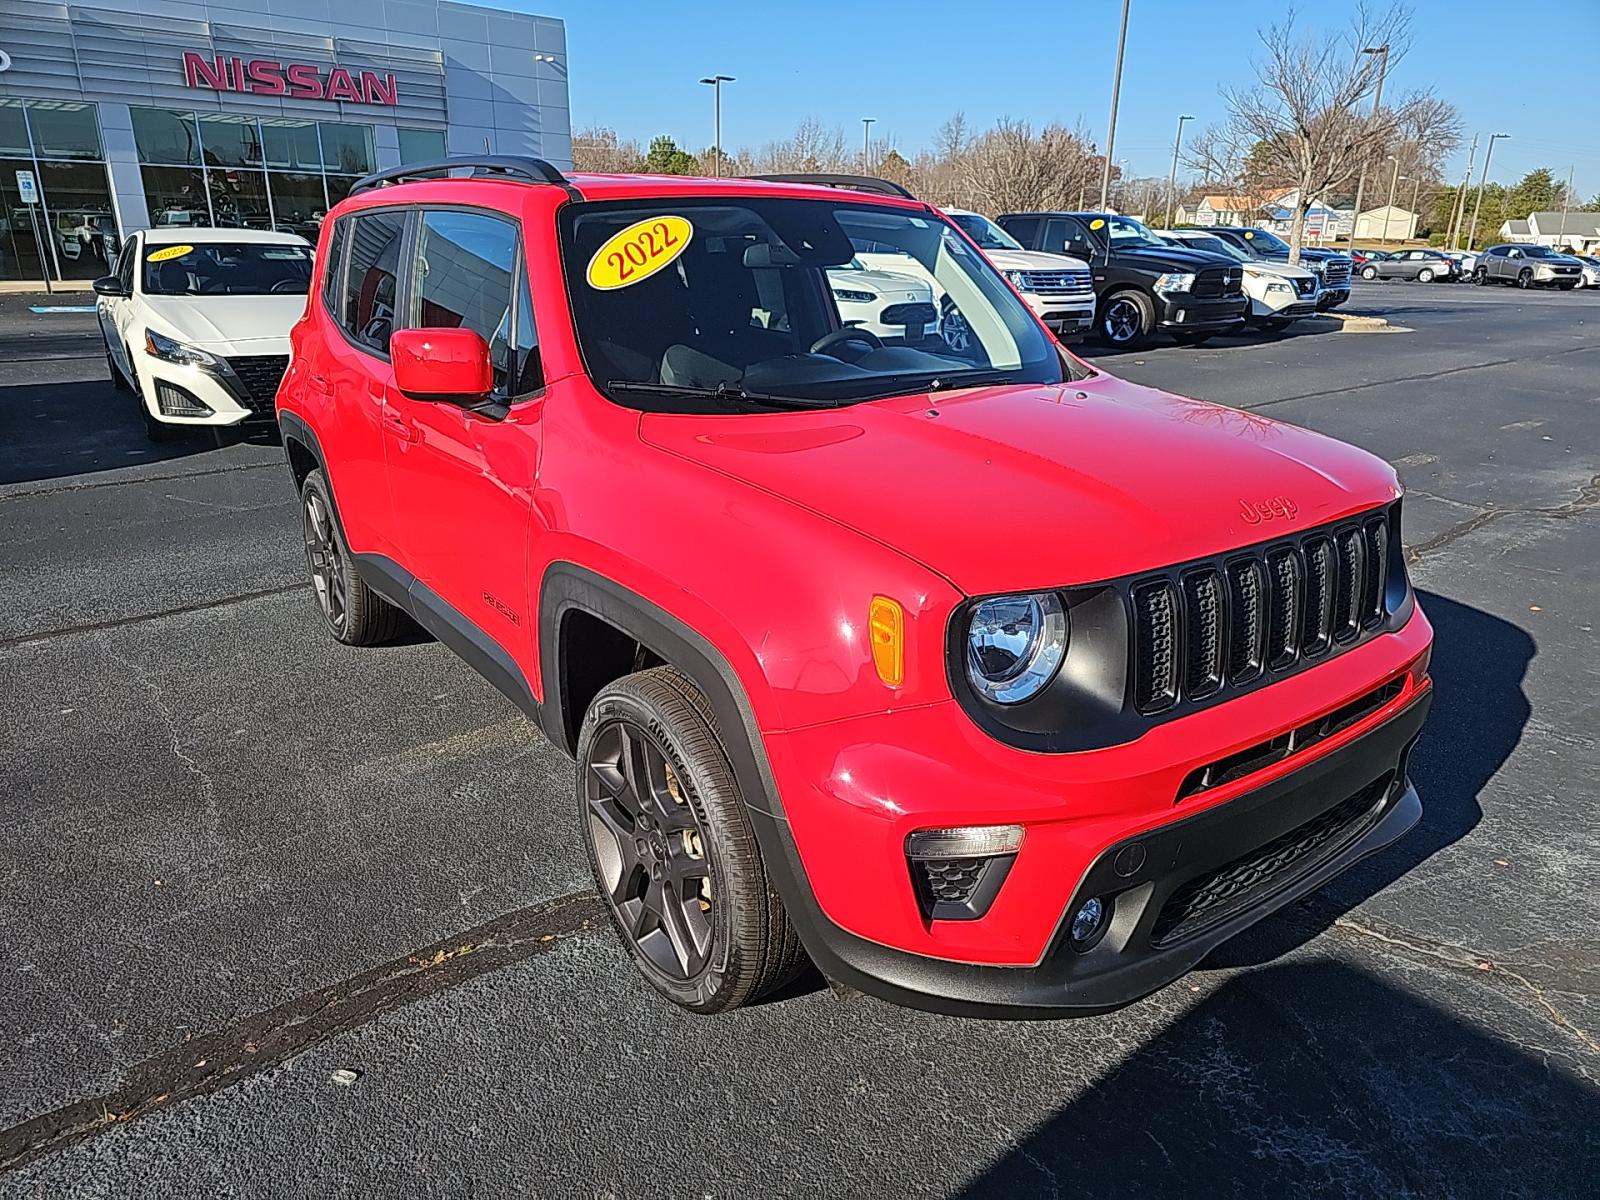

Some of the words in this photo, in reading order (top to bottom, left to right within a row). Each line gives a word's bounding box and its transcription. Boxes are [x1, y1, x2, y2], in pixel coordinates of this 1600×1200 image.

[182, 51, 398, 106] NISSAN
[155, 246, 187, 260] 2022
[607, 223, 679, 281] 2022
[1239, 497, 1298, 525] Jeep
